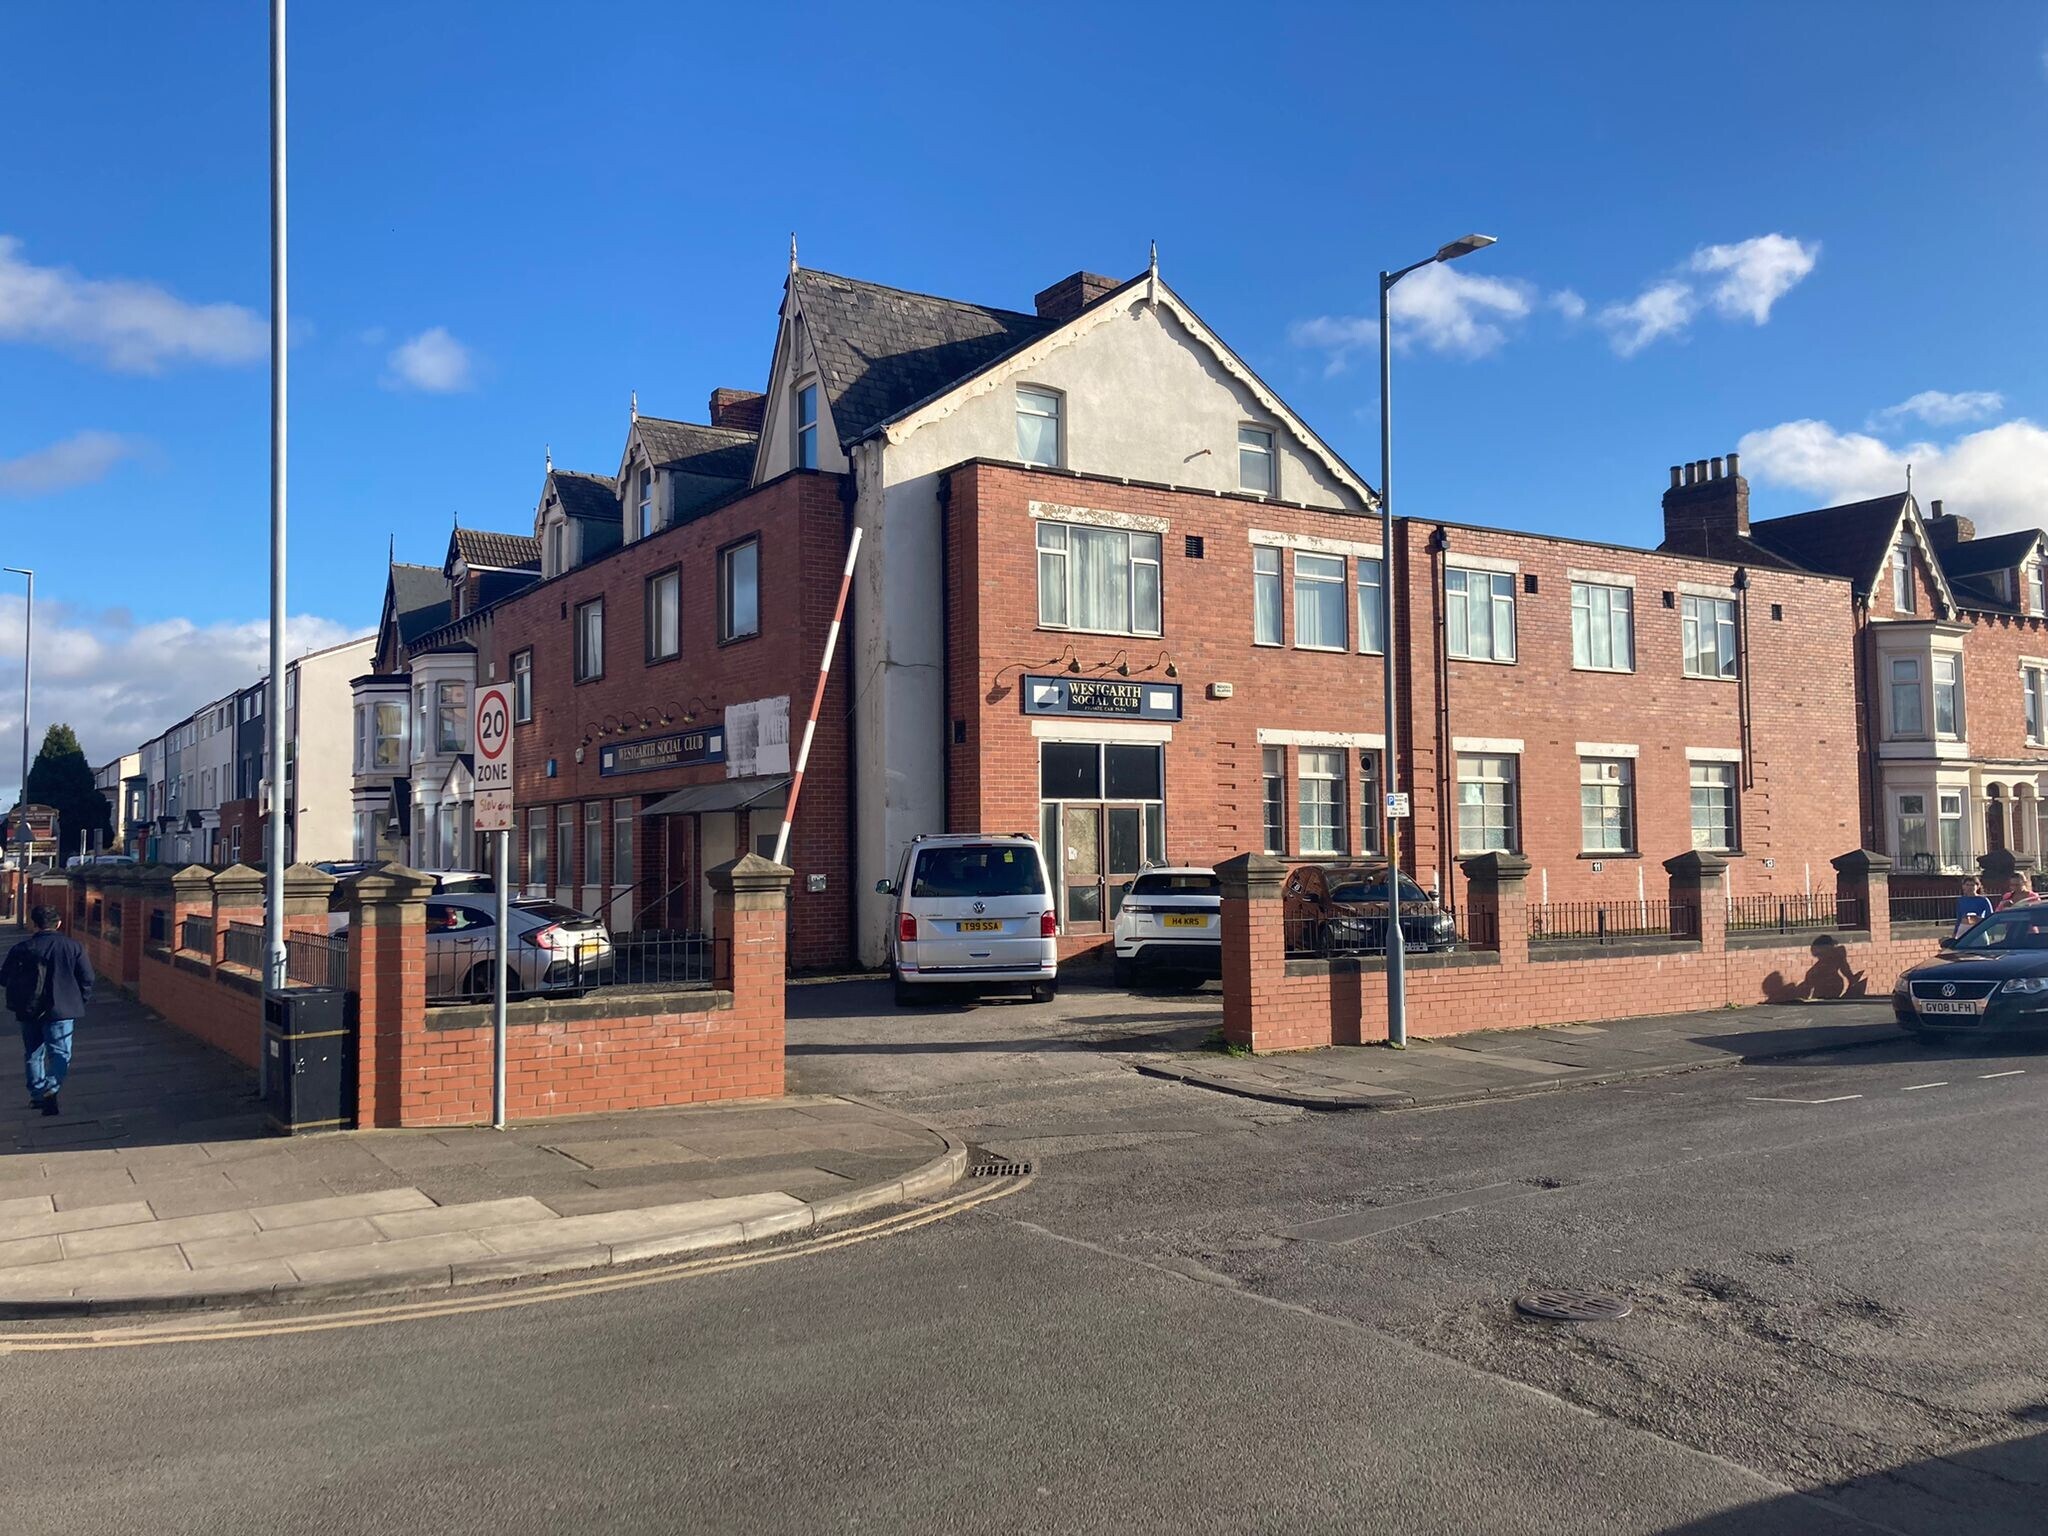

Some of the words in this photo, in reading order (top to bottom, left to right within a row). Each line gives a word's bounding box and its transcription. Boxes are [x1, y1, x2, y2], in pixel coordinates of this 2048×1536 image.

[1069, 683, 1141, 698] WESTGARTH
[1072, 695, 1109, 706] SOCIAL
[1113, 697, 1138, 707] CLUB
[482, 710, 504, 739] 20
[618, 743, 656, 760] WESTGARTH
[657, 739, 682, 755] SOCIAL
[684, 735, 704, 751] CLUB
[478, 763, 507, 782] ZONE
[964, 922, 980, 931] T99
[983, 922, 999, 931] SSA
[1171, 917, 1182, 925] H4
[1951, 1003, 1971, 1012] LFH
